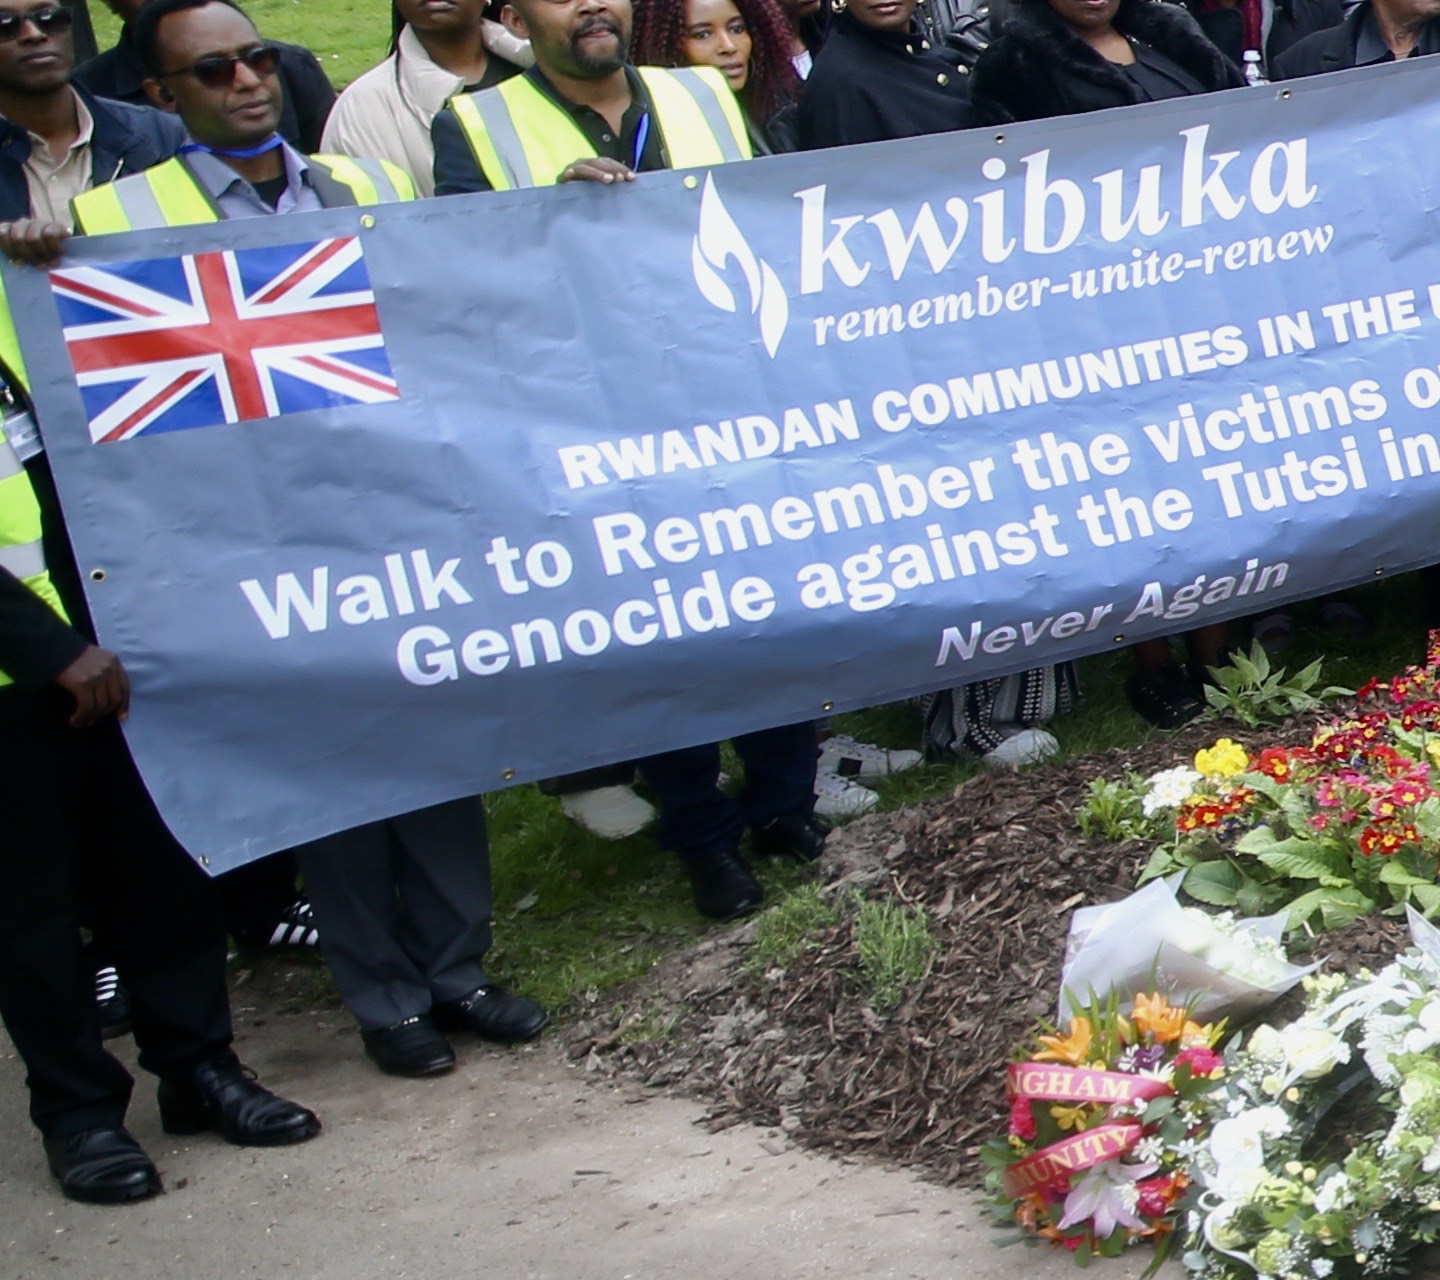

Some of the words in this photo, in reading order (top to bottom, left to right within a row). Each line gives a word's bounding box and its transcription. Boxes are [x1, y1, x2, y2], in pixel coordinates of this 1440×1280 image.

[795, 124, 1318, 295] kwibuka
[813, 223, 1335, 346] remember-unite-renew
[559, 399, 860, 488] RWANDAN
[873, 324, 1249, 428] COMMUNITIES
[1257, 311, 1316, 358] IN
[1323, 290, 1424, 345] THE
[240, 548, 474, 640] Walk
[486, 536, 573, 594] to
[592, 458, 993, 577] Remember
[1011, 423, 1131, 492] the
[1142, 360, 1388, 465] victims
[396, 567, 778, 687] Genocide
[798, 500, 1070, 614] against
[1076, 476, 1195, 545] the
[1203, 446, 1369, 521] Tutsi
[934, 602, 1114, 668] Never
[1123, 558, 1290, 624] Again
